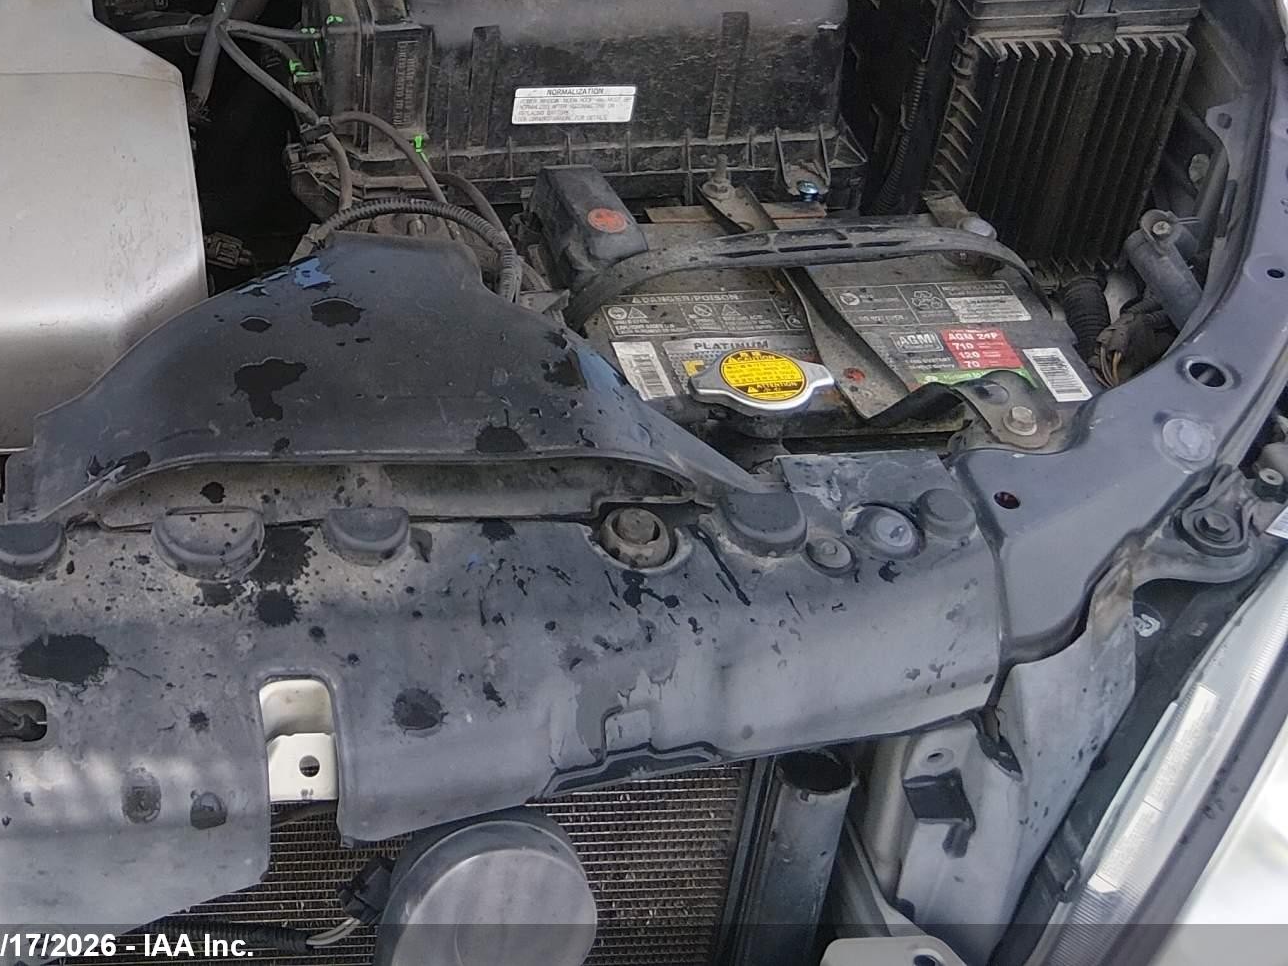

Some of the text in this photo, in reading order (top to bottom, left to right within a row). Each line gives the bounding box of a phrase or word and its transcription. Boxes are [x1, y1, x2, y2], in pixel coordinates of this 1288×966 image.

[546, 87, 605, 96] NORMALIZATION
[899, 333, 933, 346] AGM
[948, 332, 976, 341] AGM
[693, 340, 769, 350] PLATINUM
[951, 342, 975, 351] 710
[958, 351, 981, 359] 120
[963, 360, 981, 368] 70
